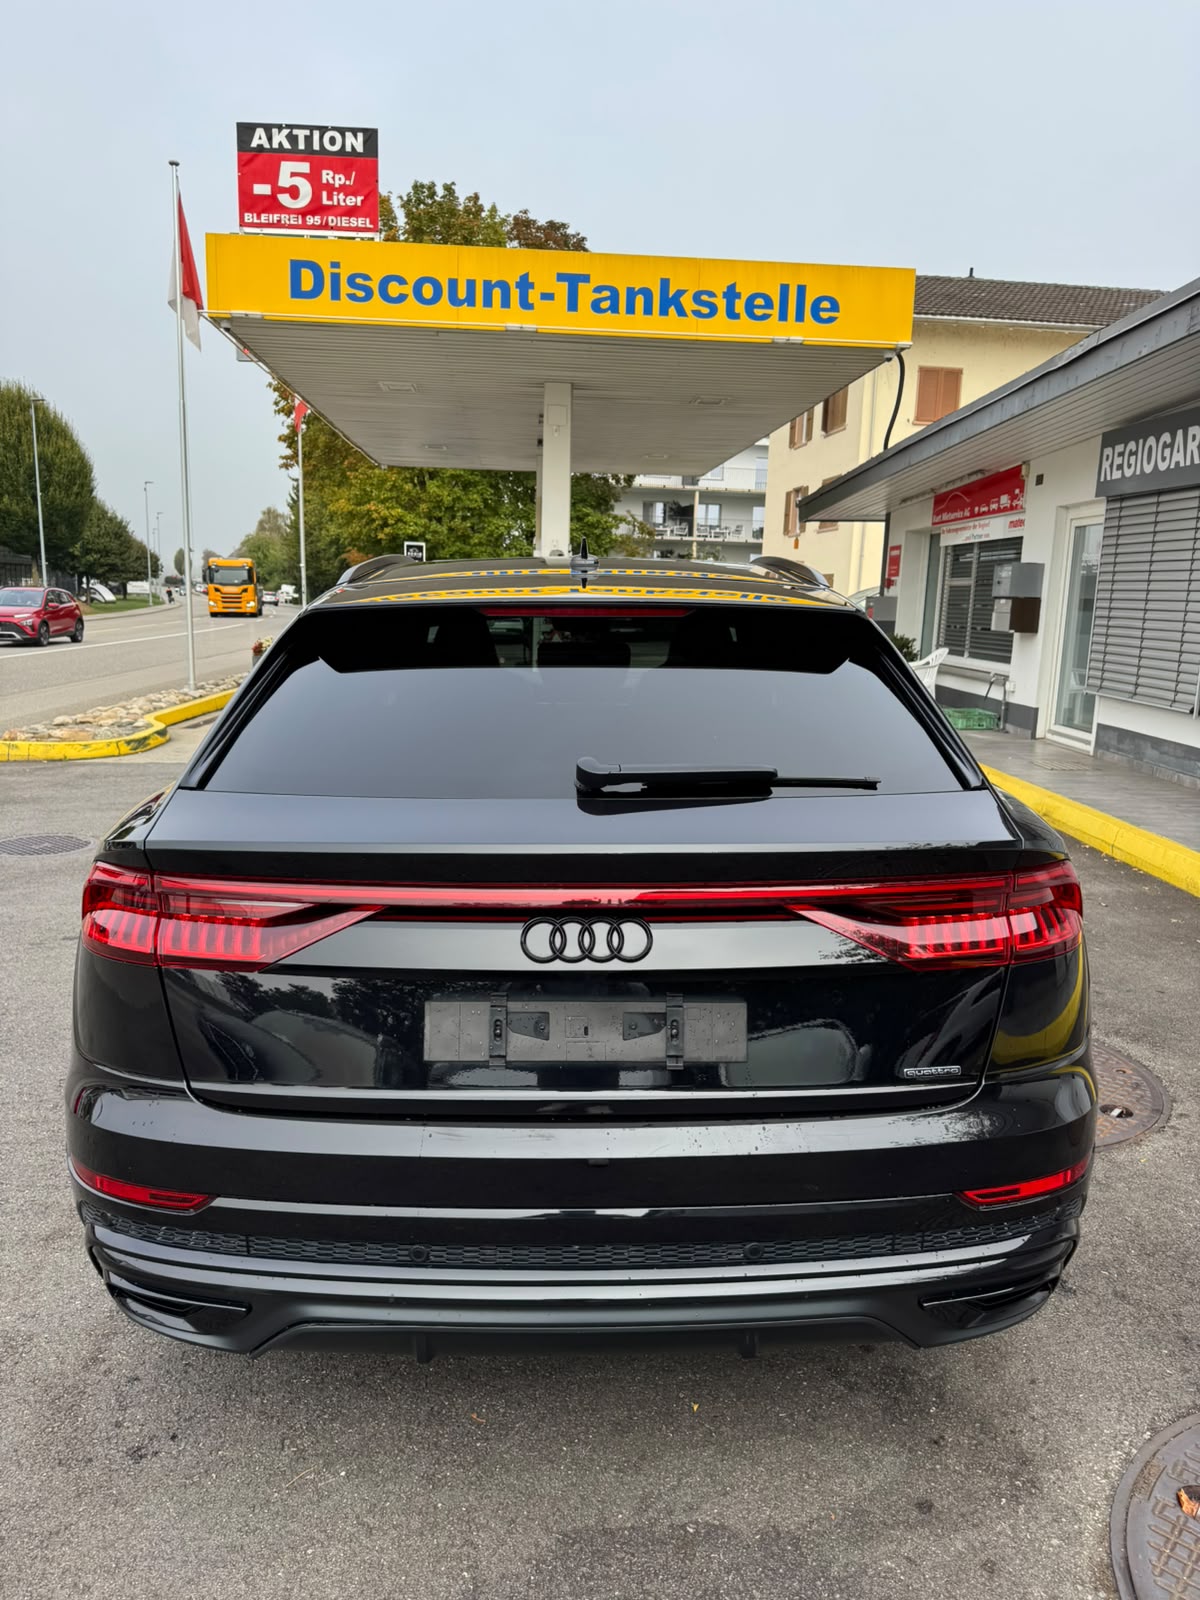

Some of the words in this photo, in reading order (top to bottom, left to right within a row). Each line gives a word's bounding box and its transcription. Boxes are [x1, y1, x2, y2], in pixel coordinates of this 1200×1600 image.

[251, 127, 363, 152] AKTION
[252, 161, 313, 209] -5
[321, 169, 356, 188] Rp./
[321, 191, 364, 207] Liter
[244, 212, 303, 225] BLEIFREI
[289, 259, 840, 325] Discount-Tankstelle
[1100, 425, 1200, 482] REGIOGAR
[906, 1067, 959, 1077] quattro
